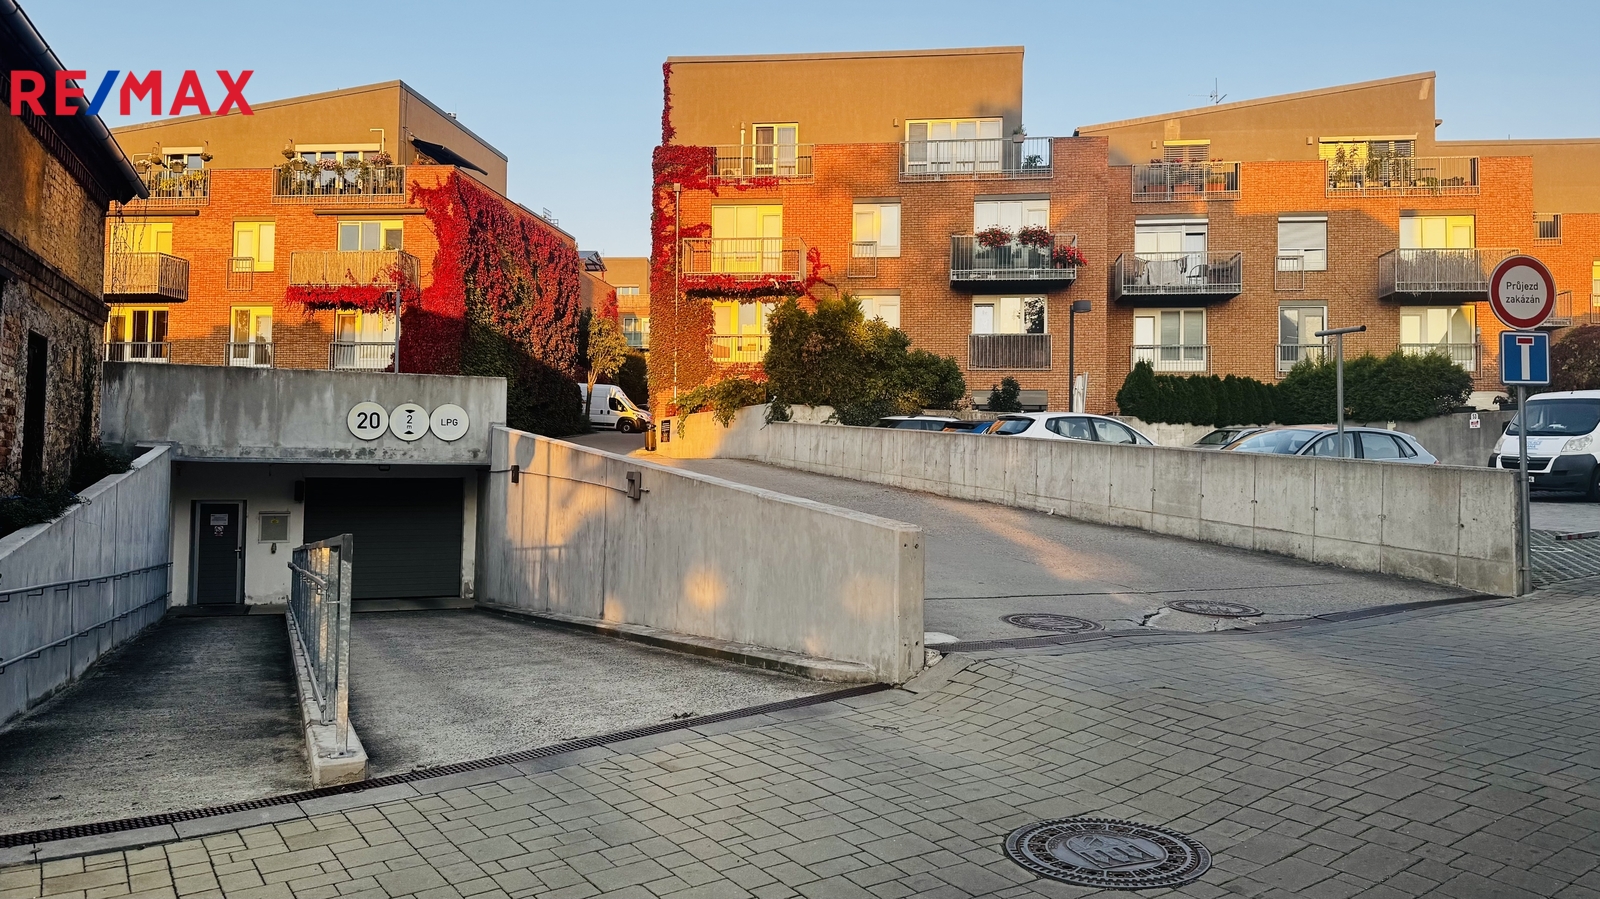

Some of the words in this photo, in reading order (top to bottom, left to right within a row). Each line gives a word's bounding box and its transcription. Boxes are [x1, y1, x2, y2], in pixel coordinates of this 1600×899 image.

[1506, 281, 1539, 292] Průjezd
[1505, 294, 1540, 303] zakázán
[357, 412, 380, 429] 20
[406, 415, 413, 424] 2
[440, 418, 458, 426] LPG
